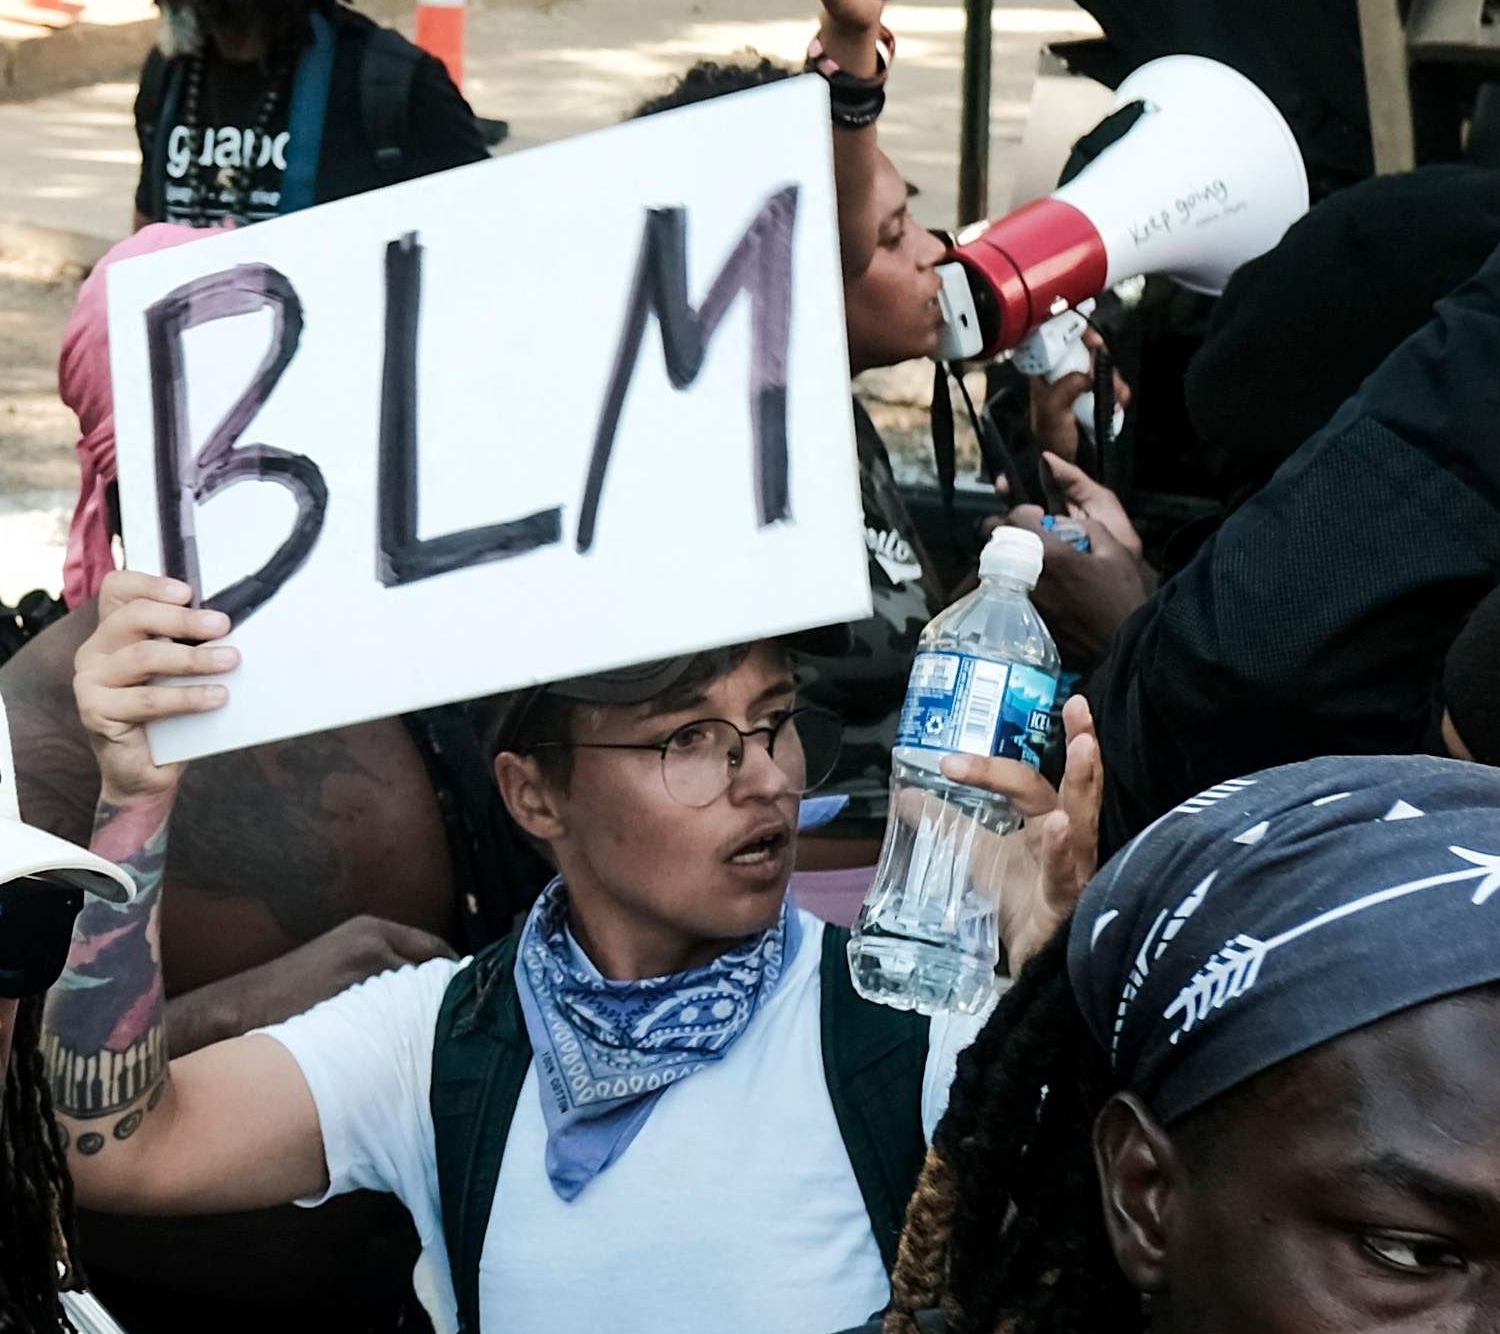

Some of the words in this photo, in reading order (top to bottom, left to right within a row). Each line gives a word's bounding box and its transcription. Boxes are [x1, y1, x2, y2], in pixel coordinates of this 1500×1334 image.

[1127, 209, 1171, 250] Keep
[1175, 178, 1228, 225] going
[144, 183, 802, 643] BLM
